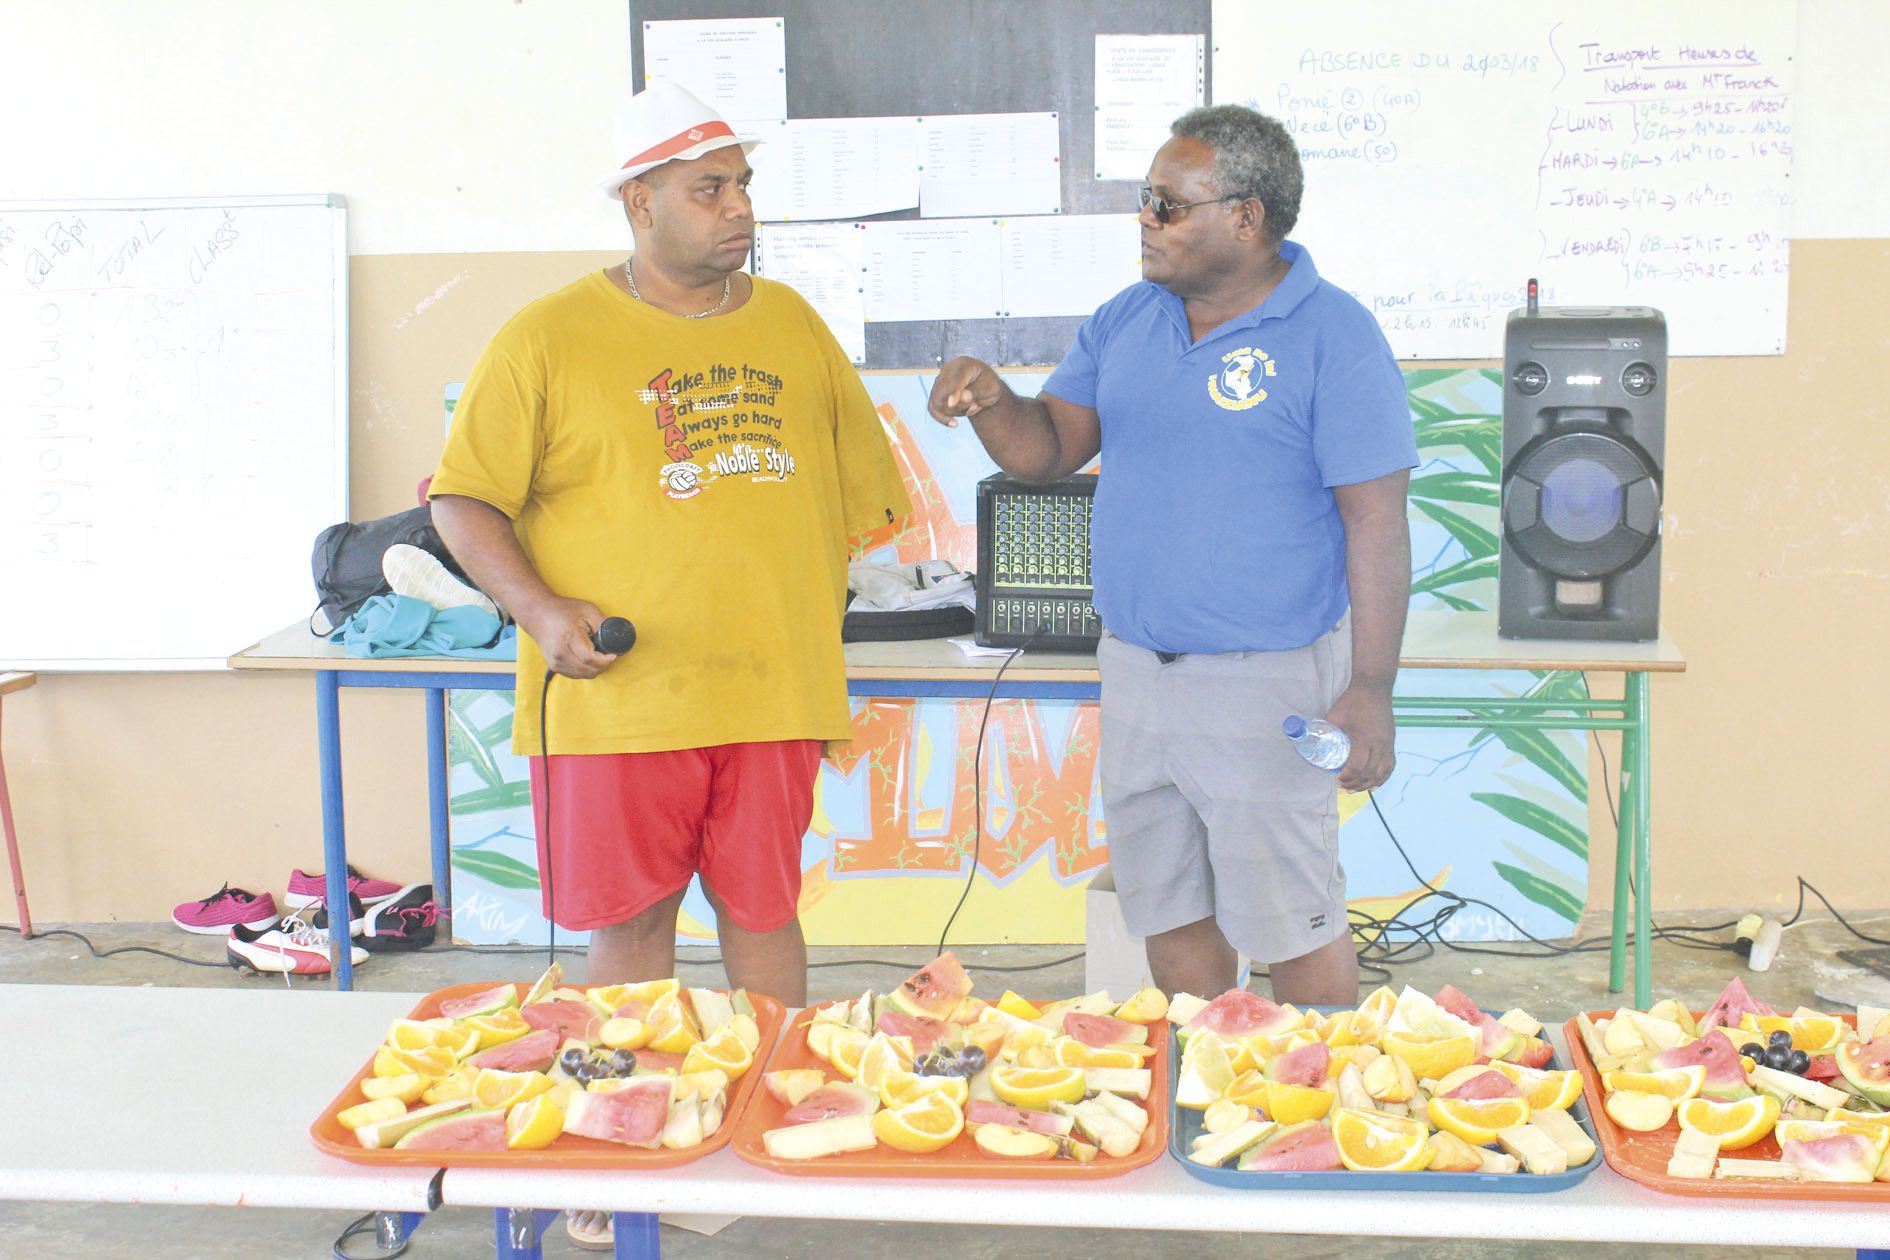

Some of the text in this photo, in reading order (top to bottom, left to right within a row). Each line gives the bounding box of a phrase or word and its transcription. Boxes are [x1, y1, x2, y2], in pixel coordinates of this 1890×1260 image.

[1299, 48, 1401, 75] ABSENCE
[1413, 53, 1450, 69] DU
[1579, 43, 1758, 69] Transport Heures de
[1724, 74, 1779, 90] Franck
[97, 219, 167, 284] TOTAL
[1374, 291, 1415, 313] pour
[710, 363, 737, 382] the
[741, 363, 783, 391] trash
[742, 391, 776, 407] sand
[732, 412, 748, 428] go
[752, 410, 782, 430] hard
[717, 432, 738, 445] the
[741, 430, 782, 450] sacrifice
[715, 446, 796, 480] Noble Style
